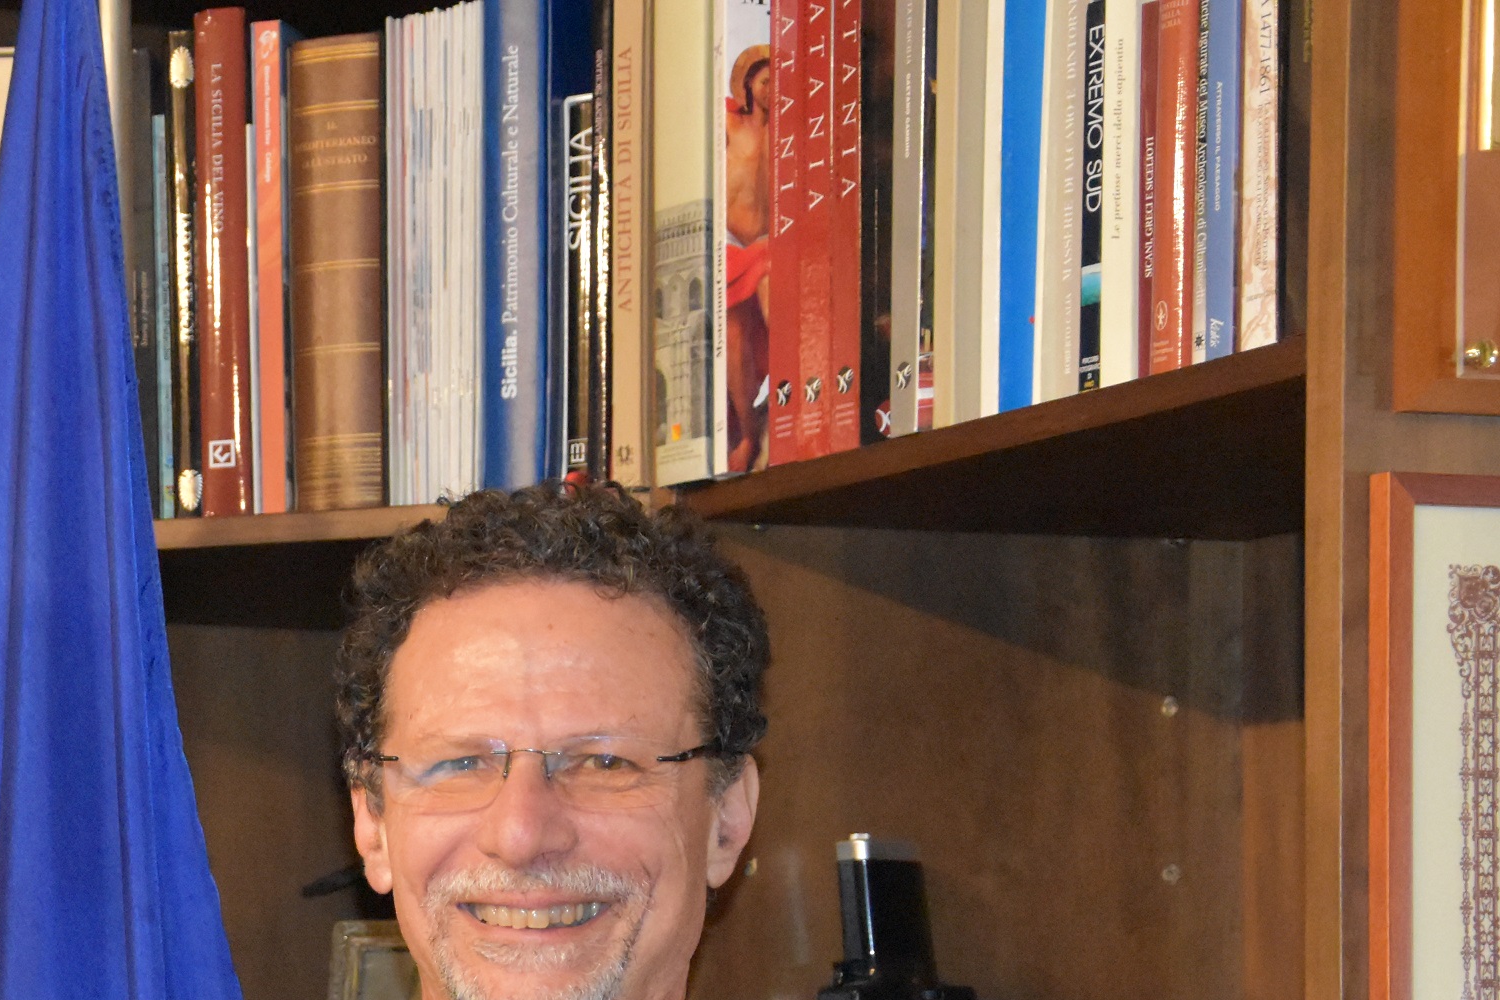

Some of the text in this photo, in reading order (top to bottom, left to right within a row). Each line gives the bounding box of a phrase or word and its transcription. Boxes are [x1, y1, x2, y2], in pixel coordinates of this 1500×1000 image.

[1198, 77, 1209, 97] del
[1258, 11, 1272, 94] 1477-1861
[209, 61, 225, 232] LA SICILIA DEL VINO
[1064, 102, 1076, 172] ALCAMO
[1084, 22, 1106, 213] EXTREMO SUD
[1109, 37, 1127, 241] Le pretiose merci della sapientia
[1196, 98, 1208, 139] Museo
[1213, 80, 1223, 212] ATTRAVERSO IL PAESAGGIO
[567, 125, 593, 251] SICILIA
[613, 46, 631, 312] ANTICHITÀ DI SICILIA
[1063, 175, 1074, 194] DI
[1143, 134, 1155, 279] SICANI, GRECI E SICELIOTI
[1194, 141, 1207, 215] Archeologico
[501, 44, 518, 398] Sicilia. Patrimonio Culturale e Naturale
[1061, 197, 1074, 282] MASSERIE
[1196, 216, 1207, 231] di
[1194, 231, 1206, 308] Caltanissetta
